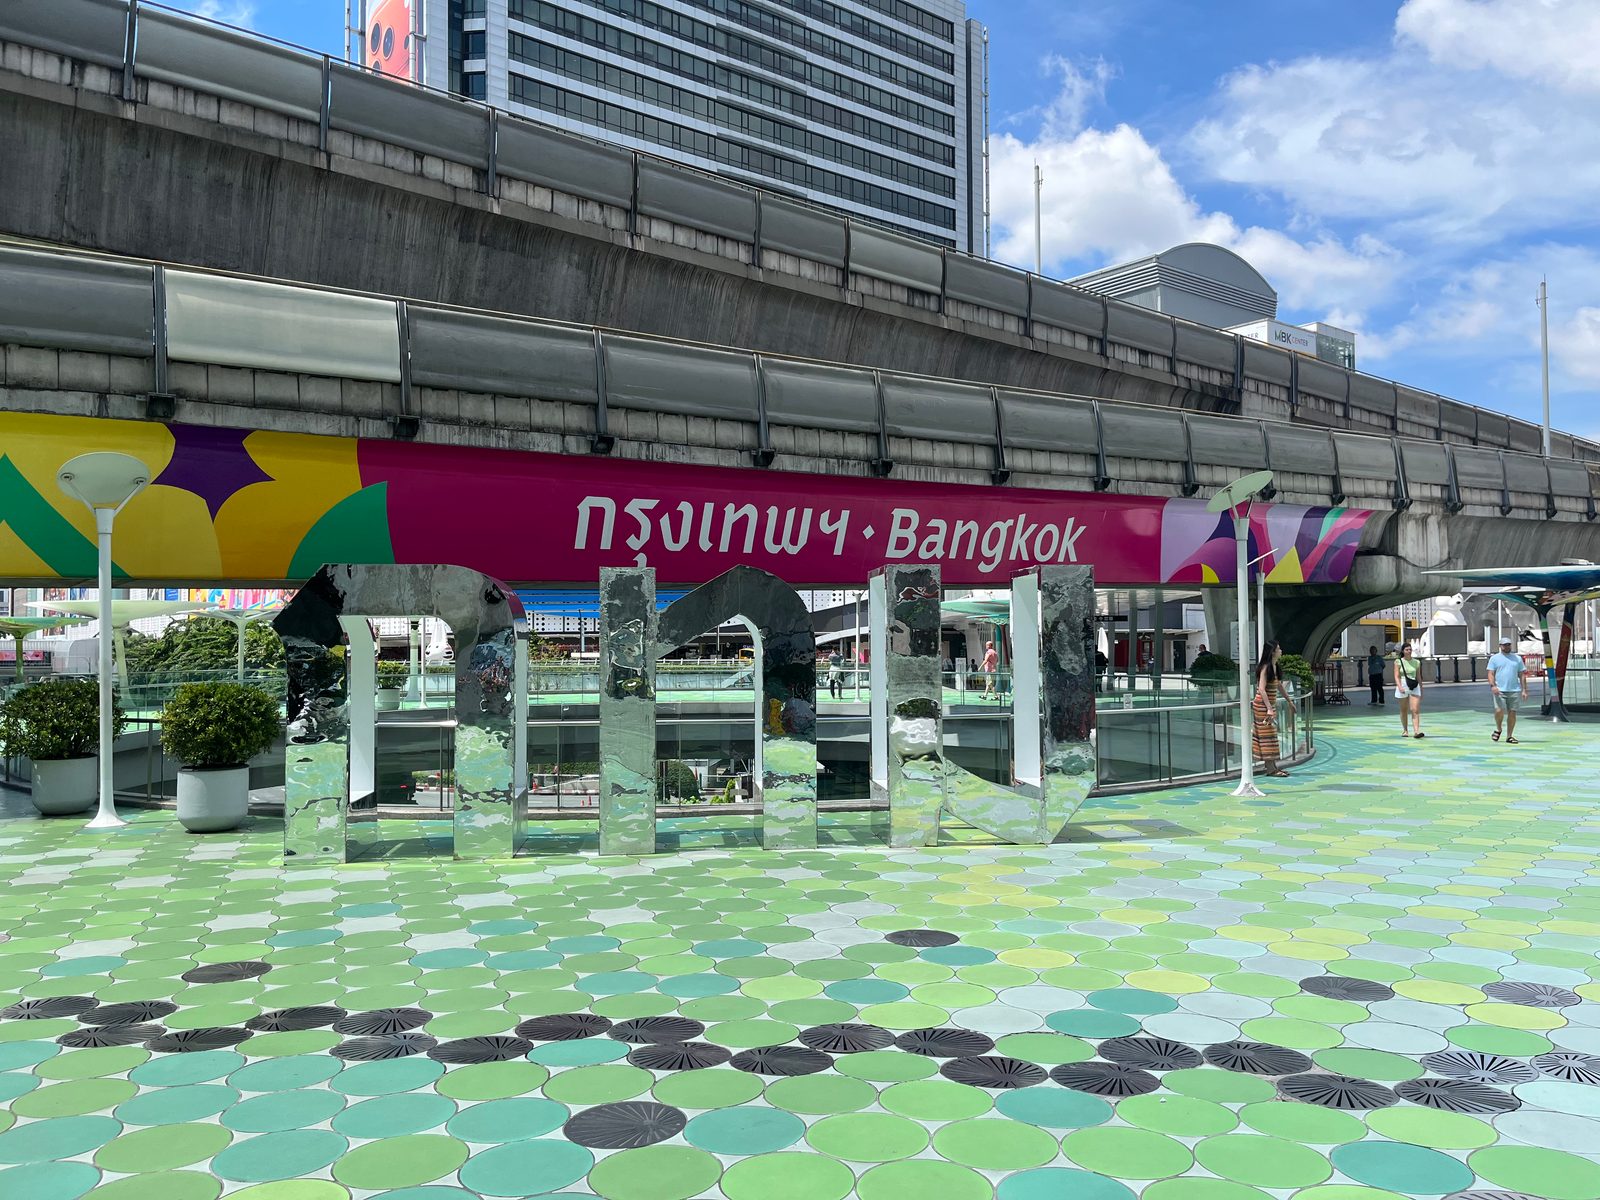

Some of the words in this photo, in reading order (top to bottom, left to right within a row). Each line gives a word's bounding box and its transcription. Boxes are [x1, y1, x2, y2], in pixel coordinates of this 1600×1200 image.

[1275, 329, 1291, 344] MBK
[574, 495, 851, 568] กรุงเทพฯ
[885, 508, 1087, 573] Bangkok
